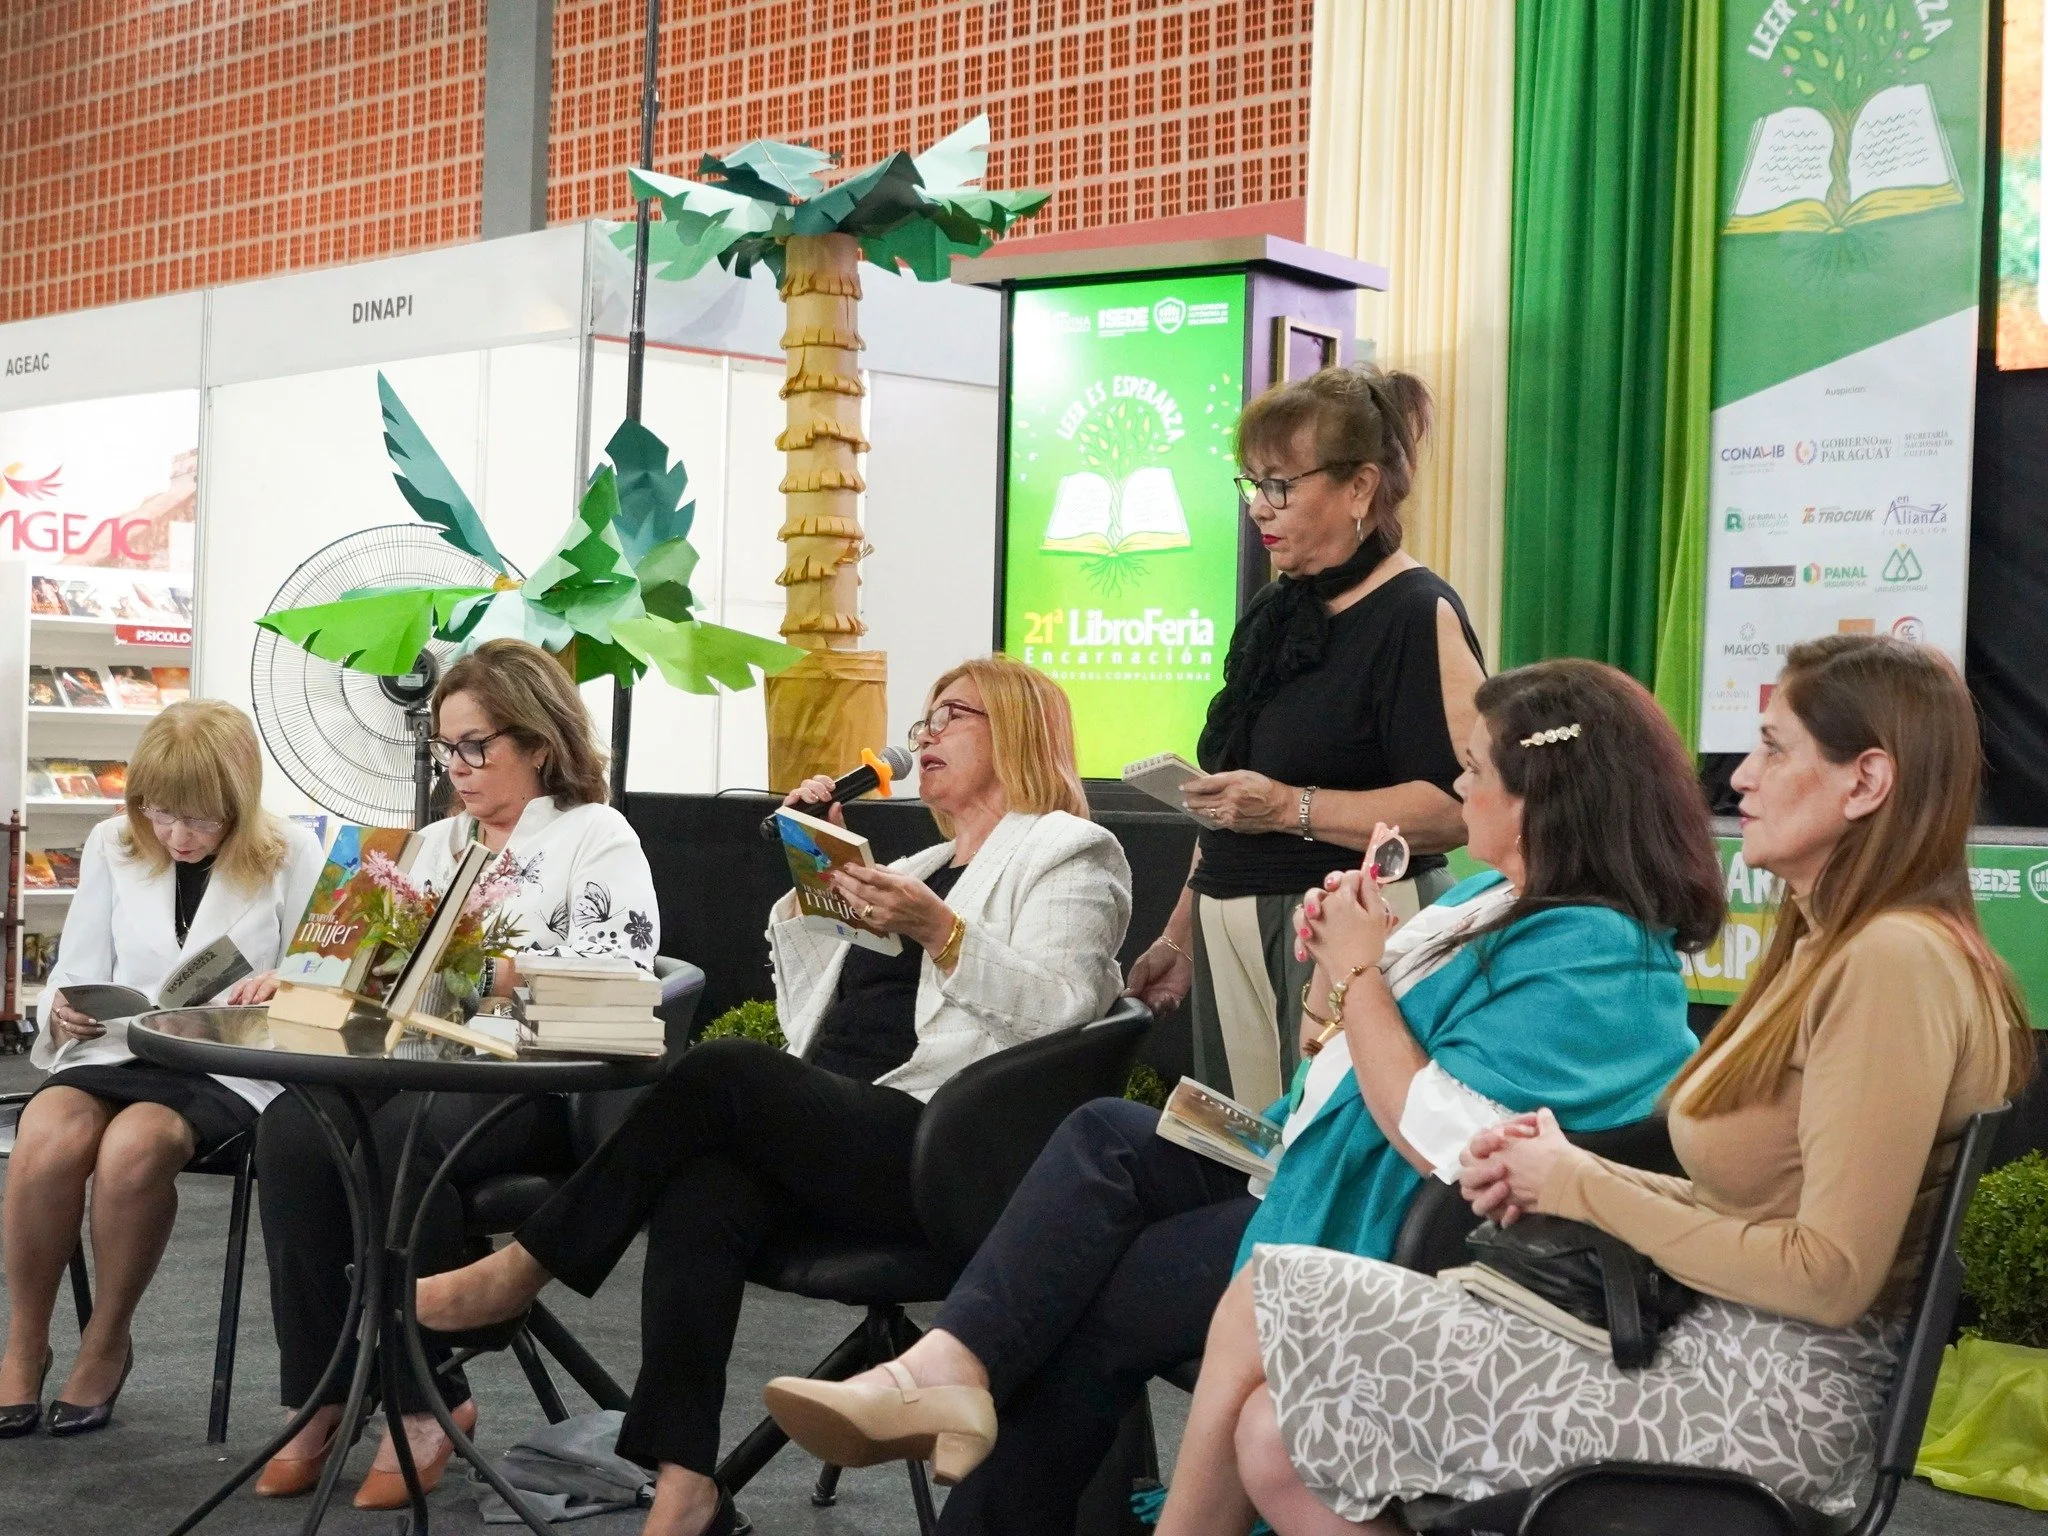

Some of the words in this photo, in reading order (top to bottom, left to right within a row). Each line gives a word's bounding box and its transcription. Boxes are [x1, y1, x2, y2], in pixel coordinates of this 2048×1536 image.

[352, 295, 414, 325] DINAPI
[5, 352, 51, 377] AGEAC
[1056, 400, 1089, 441] LEER
[1084, 380, 1108, 408] ES
[1112, 375, 1186, 443] ESPERANZA
[1821, 436, 1879, 449] GOBIERNO
[1821, 447, 1893, 462] PARAGUAY
[1818, 509, 1876, 524] TROCIUK
[1744, 574, 1795, 586] Building
[1824, 567, 1867, 579] PANAL
[1069, 608, 1215, 646] LibroFeria
[136, 629, 191, 644] PSICOLO
[1024, 647, 1213, 665] Encarnación
[1724, 642, 1770, 656] MAKO'S
[1966, 867, 2021, 892] SEDE
[299, 921, 359, 948] mujer
